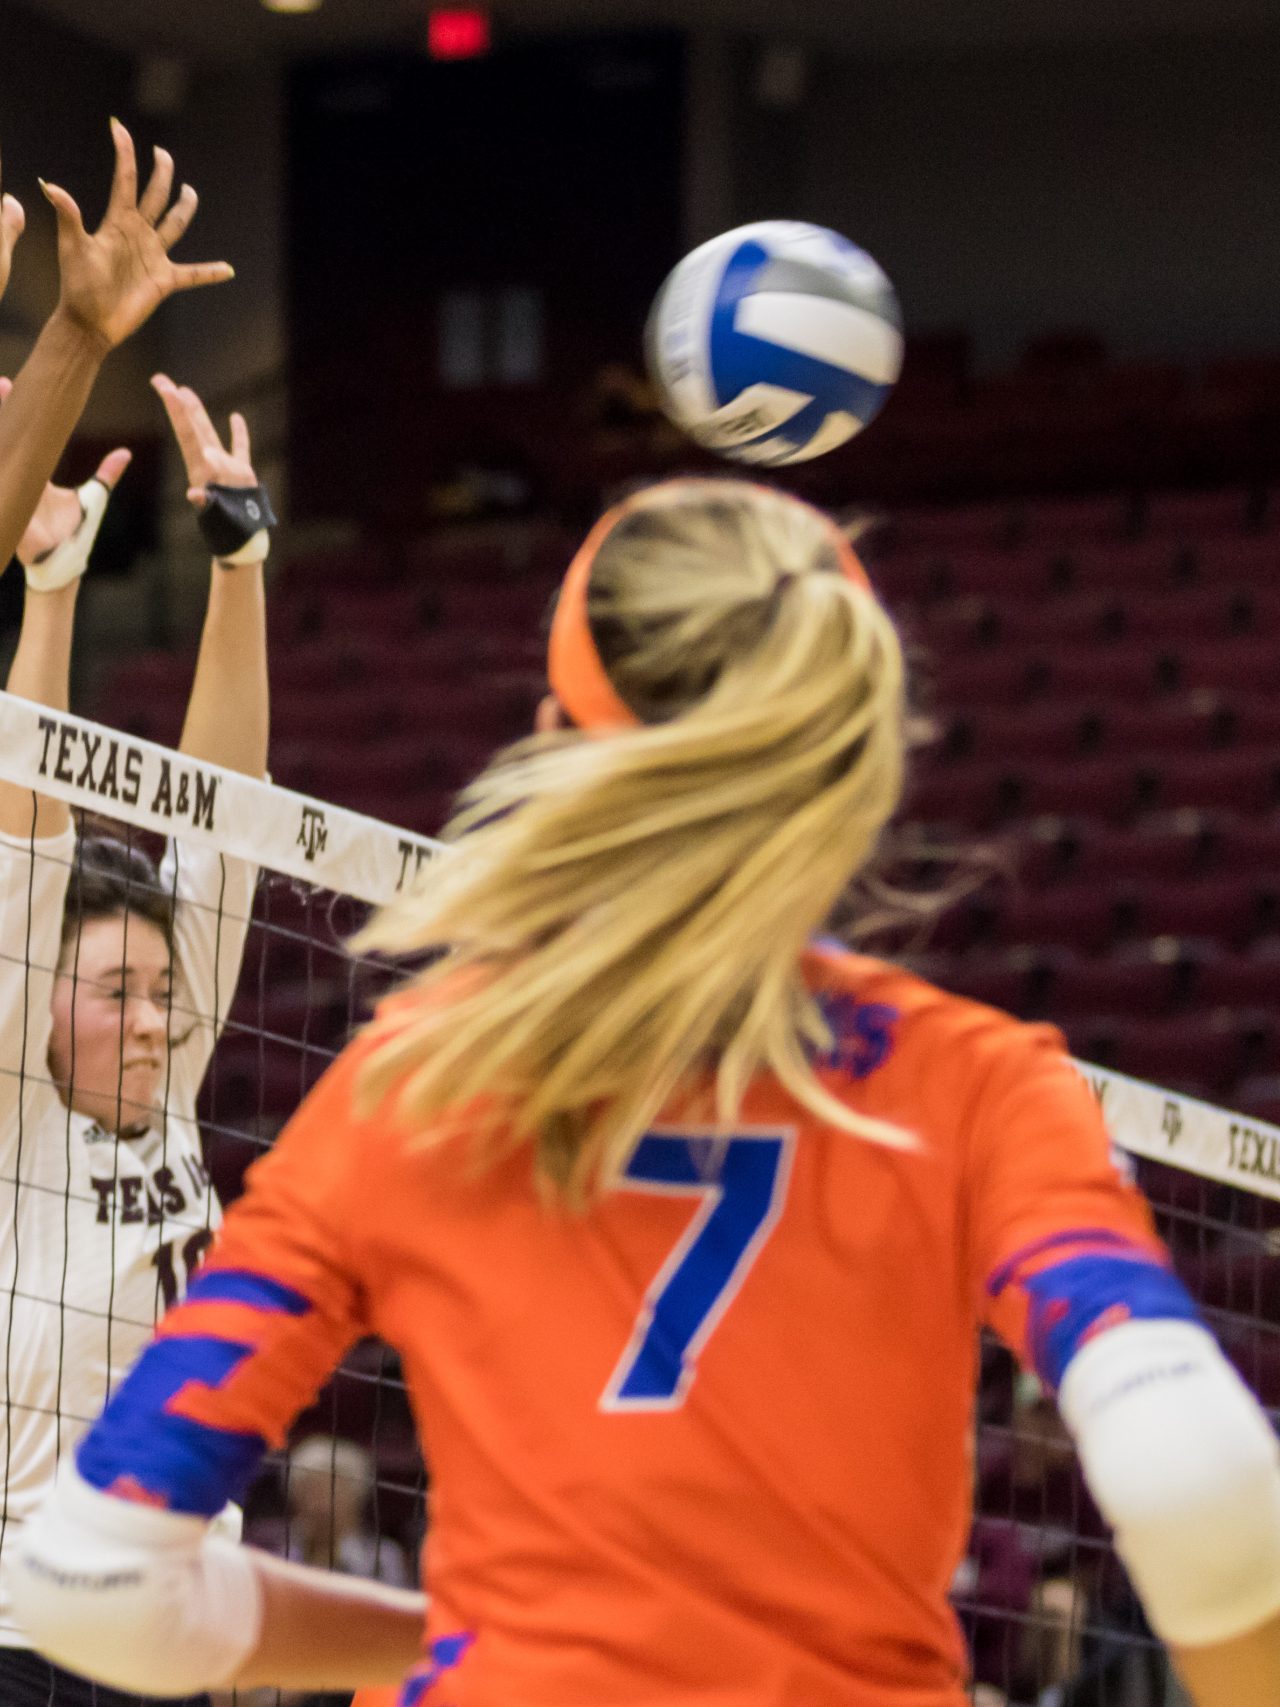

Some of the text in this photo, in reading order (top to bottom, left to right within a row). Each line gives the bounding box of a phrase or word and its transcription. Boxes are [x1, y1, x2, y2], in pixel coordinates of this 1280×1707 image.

[38, 716, 218, 831] TEXAS A&M
[599, 1123, 798, 1414] 7
